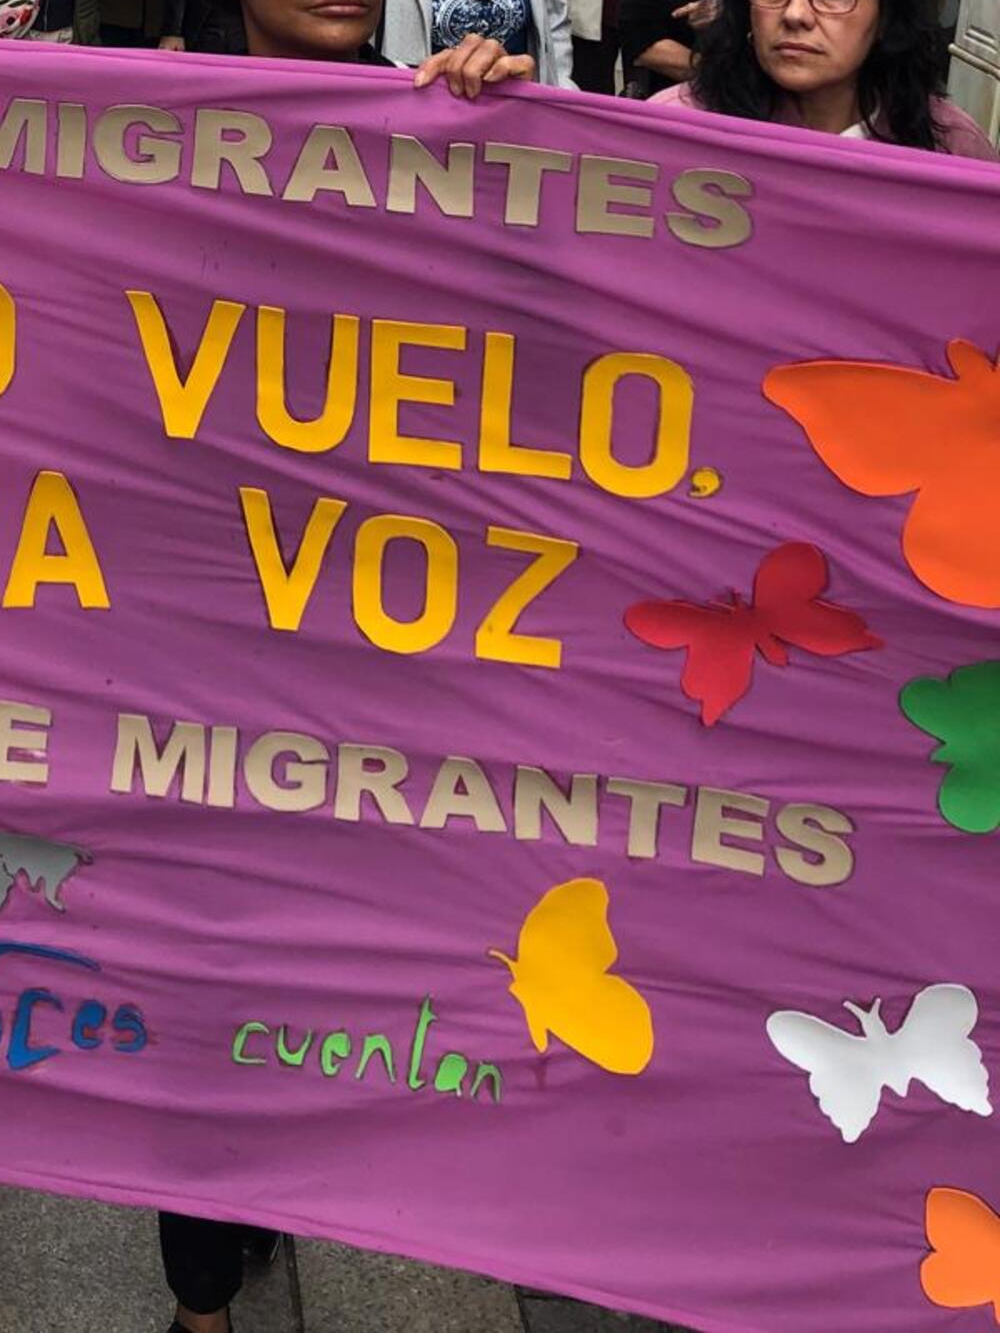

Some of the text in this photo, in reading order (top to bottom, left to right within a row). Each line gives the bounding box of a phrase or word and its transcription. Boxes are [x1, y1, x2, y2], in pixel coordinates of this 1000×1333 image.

[239, 487, 579, 669] VOZ
[110, 713, 855, 887] MIGRANTES
[231, 993, 503, 1105] cuentan
